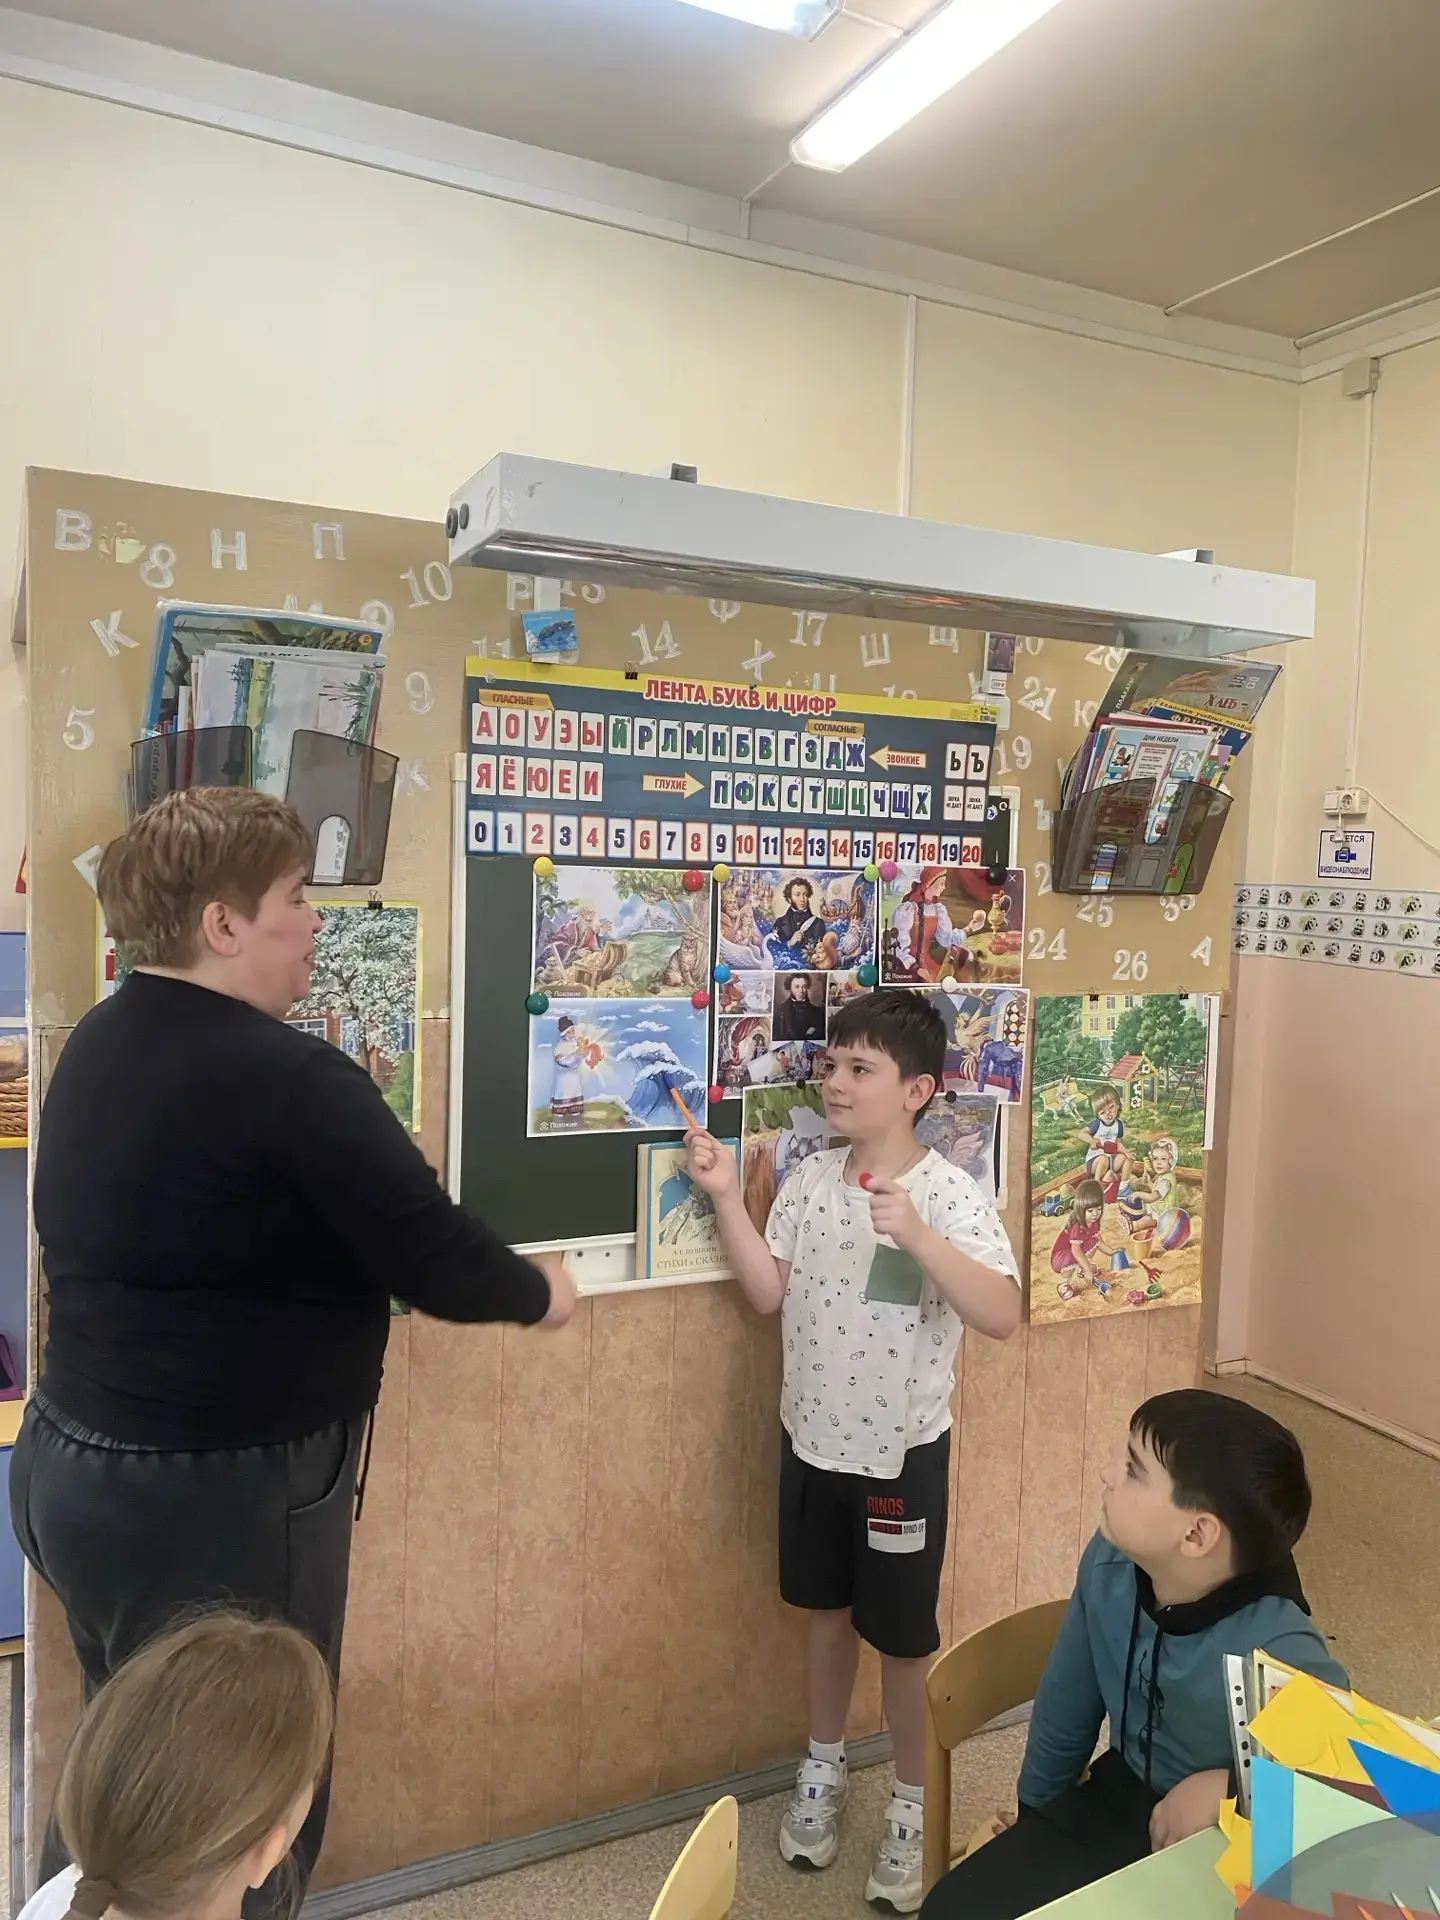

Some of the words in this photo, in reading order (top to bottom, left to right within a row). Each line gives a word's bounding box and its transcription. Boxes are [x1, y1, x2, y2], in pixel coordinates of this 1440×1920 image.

[54, 508, 92, 551] В
[312, 521, 346, 561] П
[139, 541, 176, 589] 8
[210, 528, 248, 571] Н
[400, 560, 453, 609] 10
[90, 610, 140, 656] К
[631, 620, 682, 665] 14
[789, 609, 828, 647] 17
[741, 638, 776, 682] Х
[859, 632, 891, 668] Ш
[492, 692, 534, 706] ГЛАСНЫЕ
[645, 679, 706, 703] ЛЕНТА
[712, 686, 761, 709] БУКВ
[766, 691, 779, 709] И
[784, 692, 837, 716] ЦИФР
[1017, 676, 1057, 721] 21
[1115, 677, 1135, 709] ПЛАКАТЫ
[62, 706, 97, 751] 5
[476, 711, 494, 737] А
[505, 713, 519, 739] О
[533, 715, 549, 741] У
[559, 718, 573, 744] Э
[581, 720, 603, 747] Ы
[612, 717, 628, 749] Й
[638, 726, 653, 750] Р
[661, 728, 678, 753] Л
[687, 730, 704, 755] М
[711, 731, 726, 757] Н
[736, 733, 750, 758] Б
[759, 735, 773, 760] В
[784, 738, 796, 761] Г
[805, 739, 818, 763] З
[826, 741, 842, 769] Д
[847, 743, 866, 768] Ж
[813, 722, 857, 735] СОГЛАСНЫЕ
[1157, 735, 1179, 743] НЕДЕЛИ
[476, 763, 492, 788] Я
[502, 758, 516, 791] Ё
[527, 766, 549, 792] Ю
[558, 768, 572, 794] Е
[583, 770, 599, 795] И
[886, 752, 921, 766] ЗВОНКИЕ
[654, 777, 687, 791] ГЛУХИЕ
[713, 780, 729, 804] П
[735, 780, 754, 805] Ф
[762, 782, 776, 806] К
[787, 784, 799, 808] С
[808, 785, 823, 809] Т
[827, 787, 846, 811] Ш
[851, 788, 866, 815] Ц
[873, 789, 886, 812] Ч
[892, 790, 910, 819] Щ
[915, 791, 929, 815] Х
[474, 821, 487, 843] 0
[504, 823, 514, 844] 1
[530, 824, 544, 845] 2
[559, 825, 572, 847] 3
[586, 827, 598, 848] 4
[613, 828, 626, 849] 5
[639, 830, 651, 851] 6
[665, 831, 676, 851] 7
[690, 832, 702, 852] 8
[715, 833, 727, 853] 9
[736, 835, 755, 855] 10
[762, 836, 779, 855] 11
[785, 837, 803, 856] 12
[808, 838, 826, 857] 13
[831, 838, 850, 858] 14
[854, 839, 871, 858] 15
[877, 841, 894, 860] 16
[899, 841, 916, 861] 17
[920, 842, 936, 862] 18
[941, 843, 959, 863] 19
[962, 844, 981, 864] 20
[1329, 834, 1365, 843] ВЕТСЯ
[1320, 865, 1370, 875] ВИДЕОНАБЛЮДЕНИЕ
[1027, 927, 1067, 961] 24
[1190, 935, 1212, 967] А
[1112, 949, 1149, 982] 26
